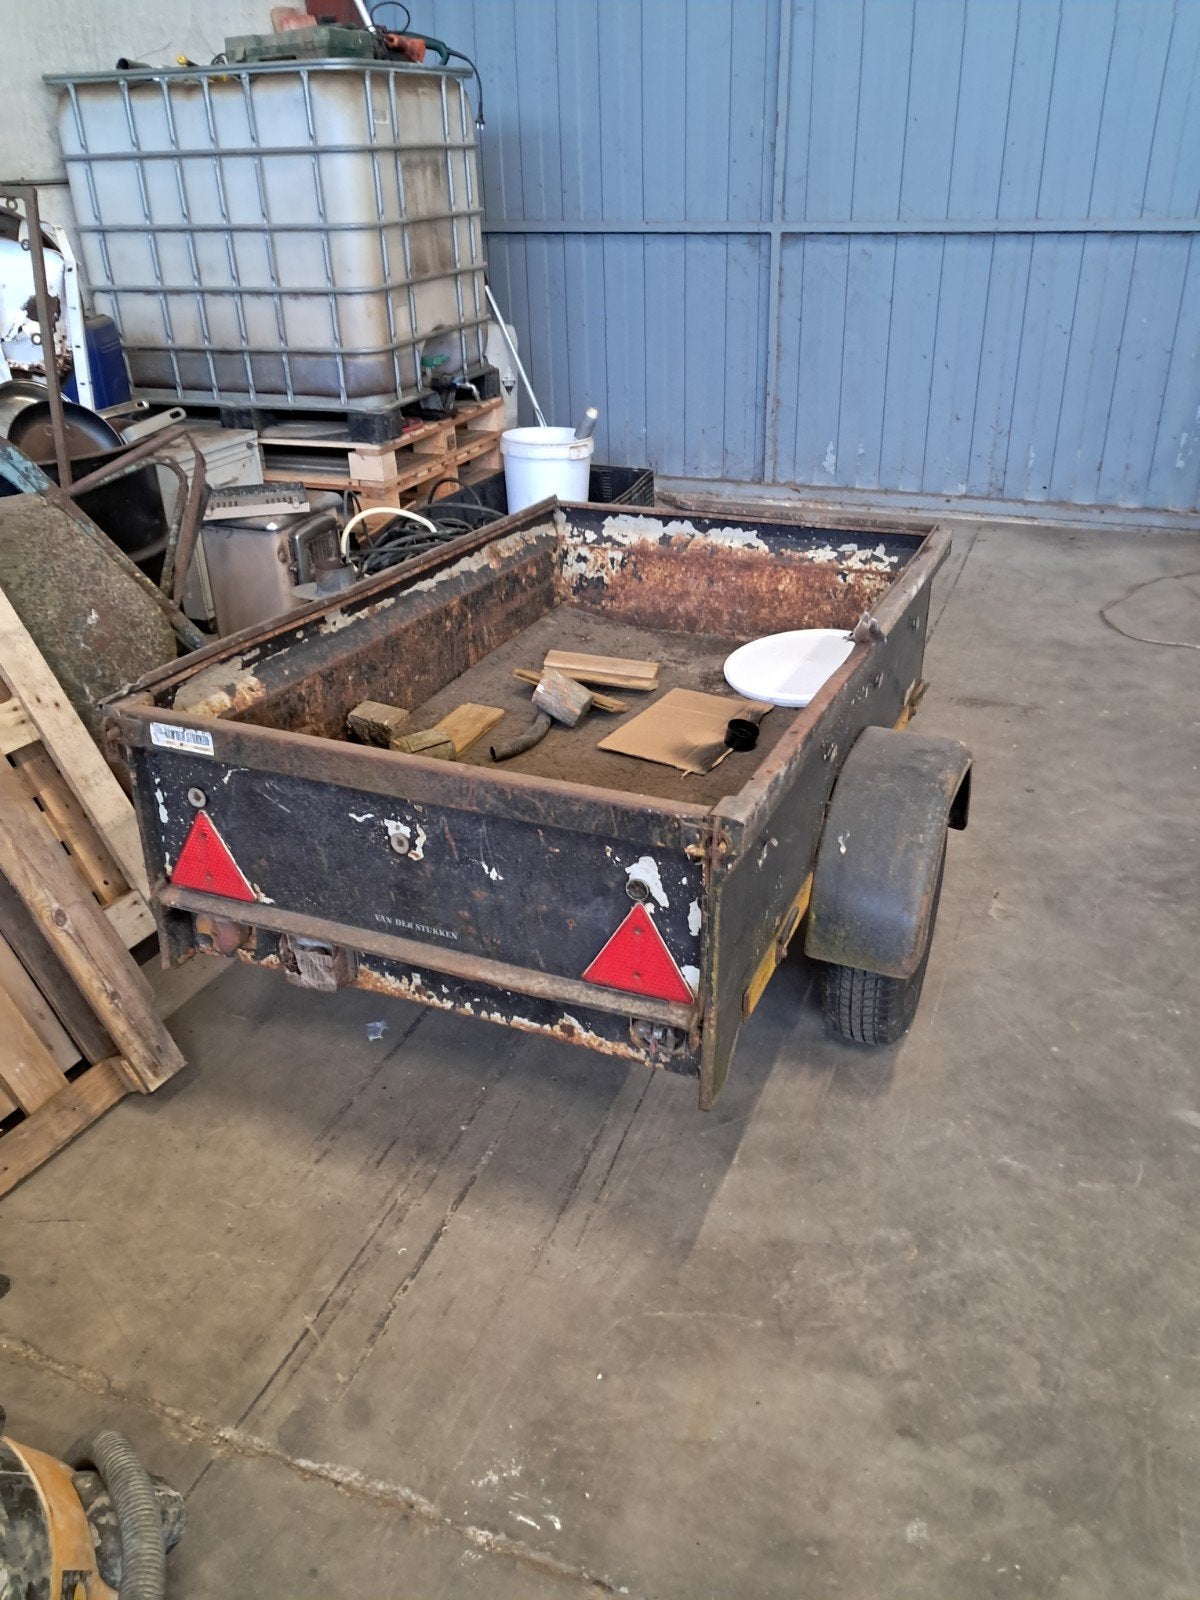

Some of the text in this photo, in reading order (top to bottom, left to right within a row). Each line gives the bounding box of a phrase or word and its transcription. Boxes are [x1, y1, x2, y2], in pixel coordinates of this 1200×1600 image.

[374, 913, 458, 940] VAN DER STUKKEN
